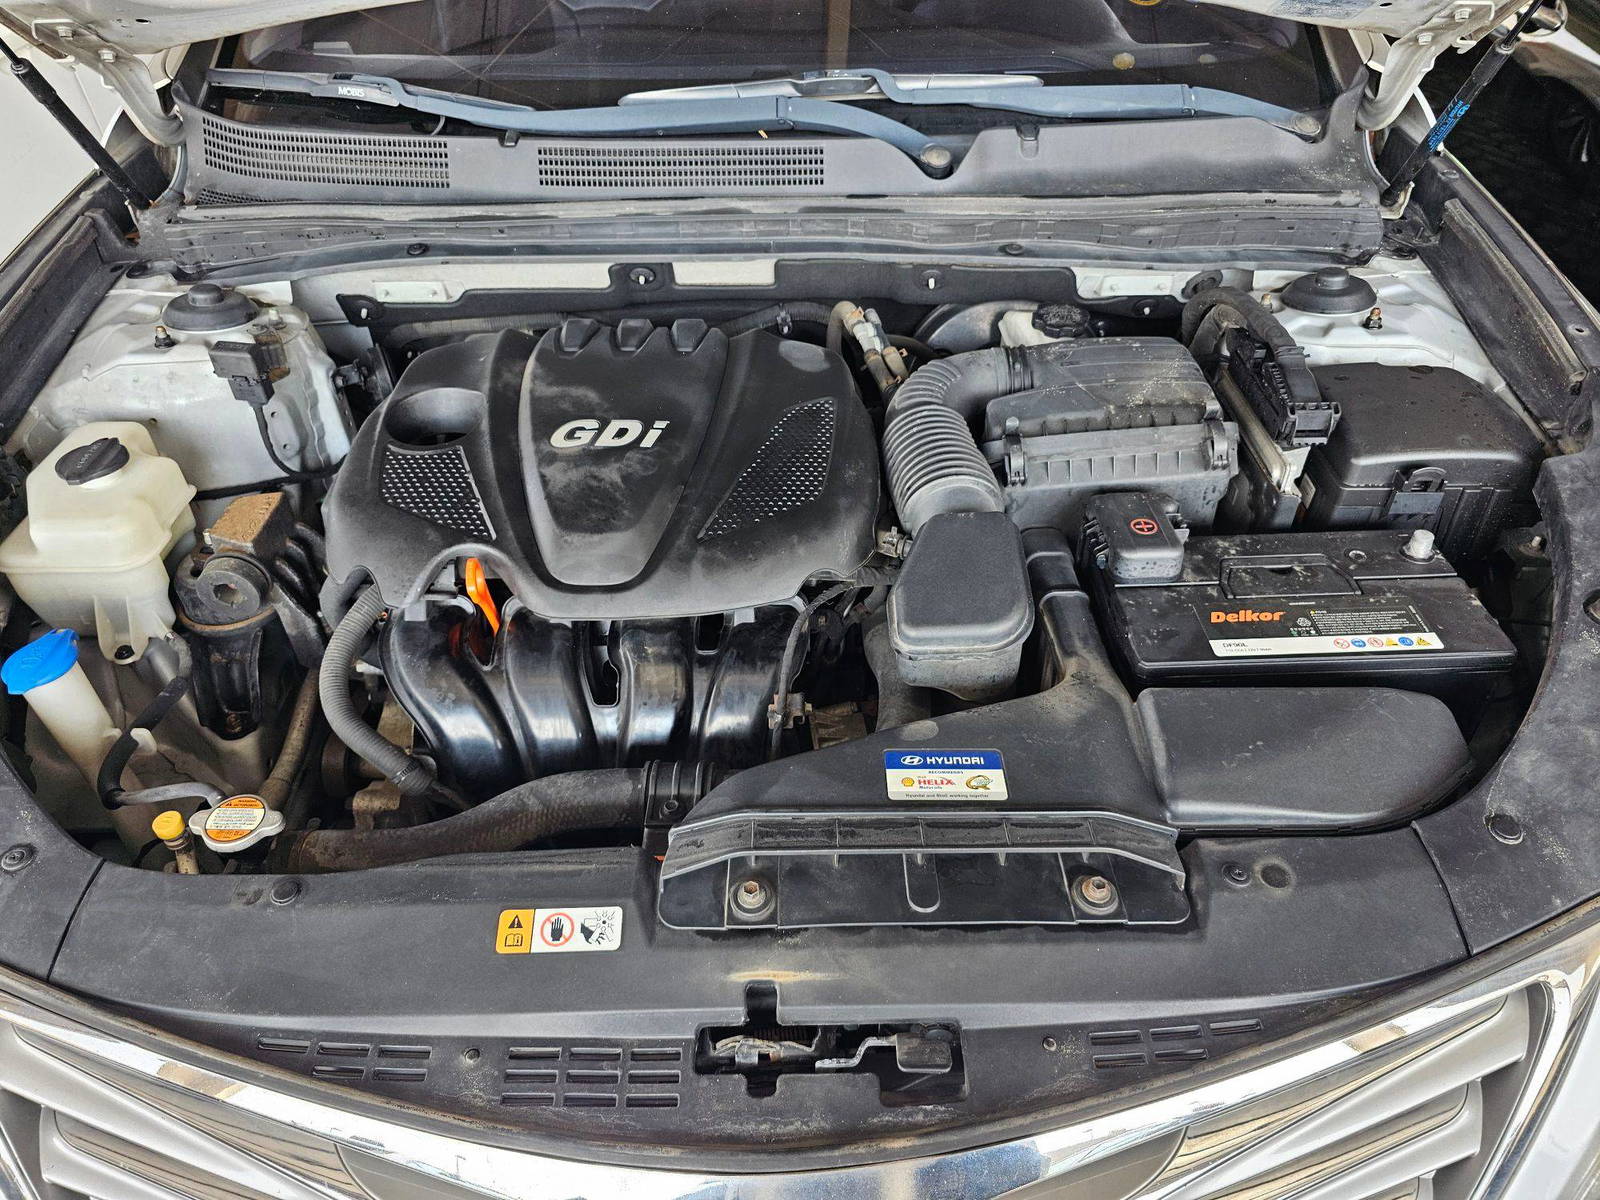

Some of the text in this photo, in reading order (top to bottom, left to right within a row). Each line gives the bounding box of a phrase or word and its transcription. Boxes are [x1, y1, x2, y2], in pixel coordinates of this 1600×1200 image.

[338, 86, 365, 97] MOBIS
[550, 419, 670, 448] GDi
[1210, 609, 1286, 623] Delkor
[926, 756, 985, 765] HYUNDAI
